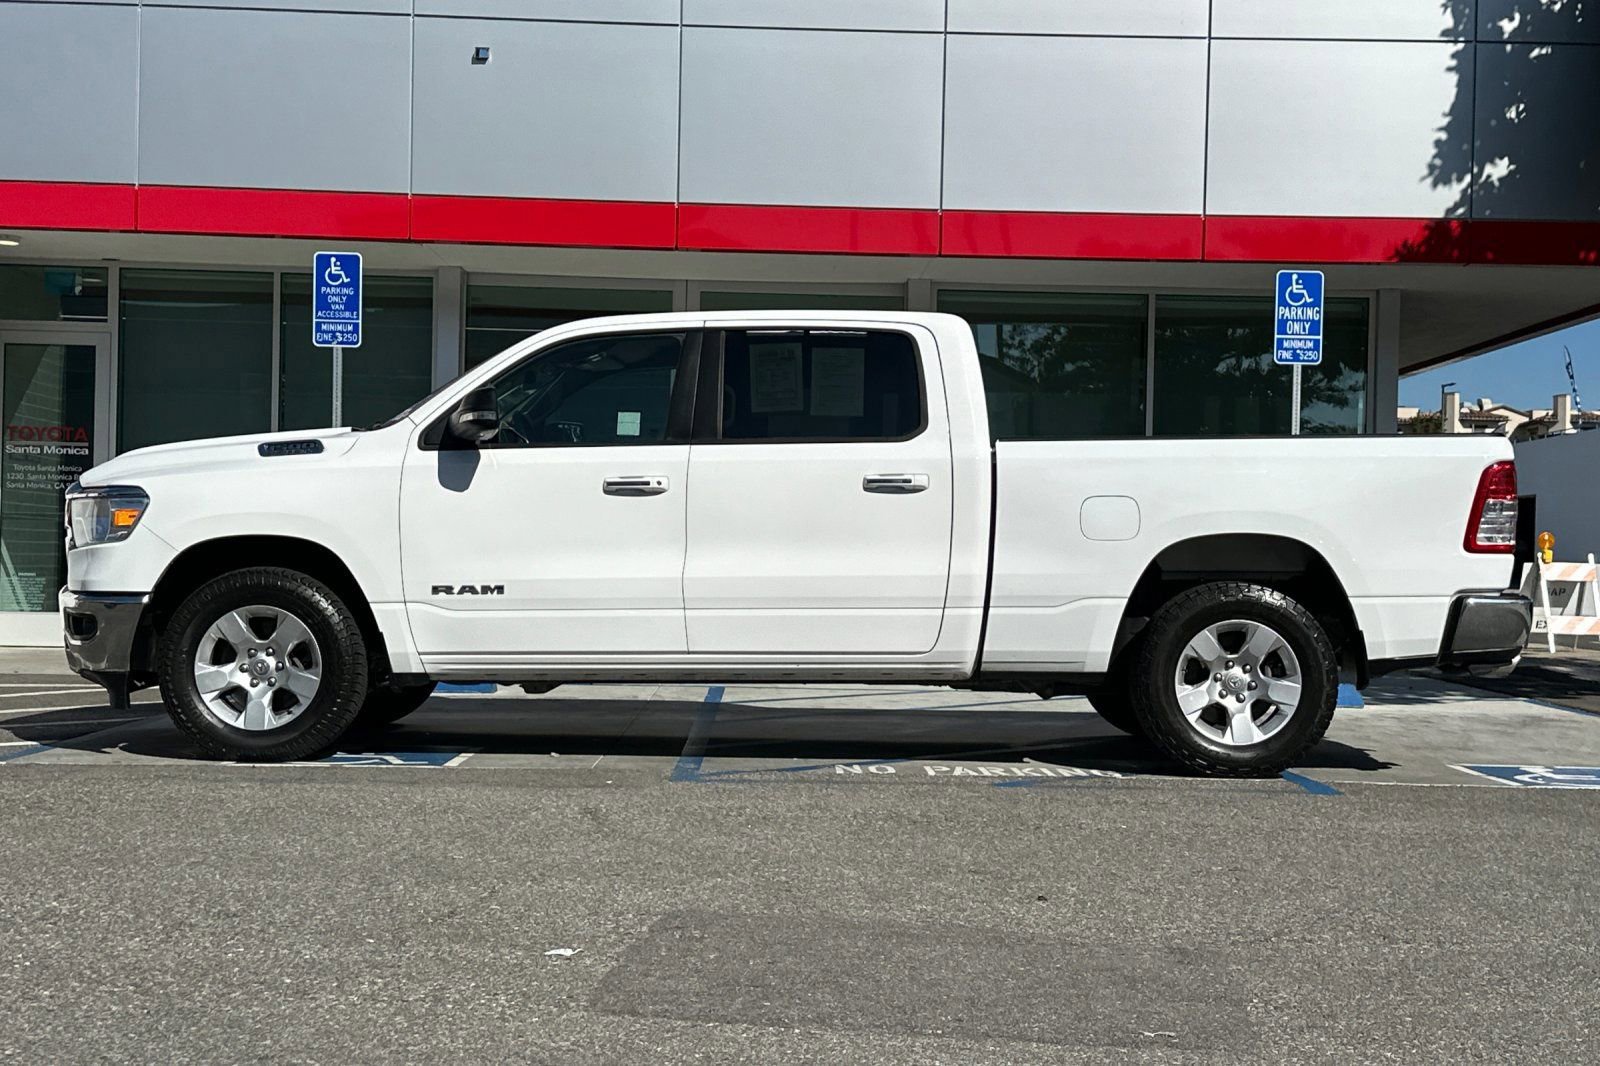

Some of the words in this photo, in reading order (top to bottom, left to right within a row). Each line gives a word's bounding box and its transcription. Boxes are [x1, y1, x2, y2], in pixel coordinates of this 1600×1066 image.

[321, 286, 355, 295] PARKING
[327, 295, 347, 303] ONLY
[316, 310, 358, 319] ACCESSIBLE
[1278, 306, 1320, 320] PARKING
[321, 323, 353, 332] MINIMUM
[1286, 320, 1311, 335] ONLY
[316, 332, 333, 341] FINE
[1283, 339, 1314, 349] MINIMUM
[1277, 350, 1294, 360] FINE
[1299, 350, 1318, 360] $250
[7, 424, 88, 441] TOYOTA
[5, 445, 40, 454] Santa
[43, 445, 89, 455] Monica
[13, 464, 36, 472] Toyota
[57, 464, 82, 472] Monica
[431, 585, 505, 595] RAM
[834, 764, 896, 774] NO
[923, 764, 1122, 778] PARKING
